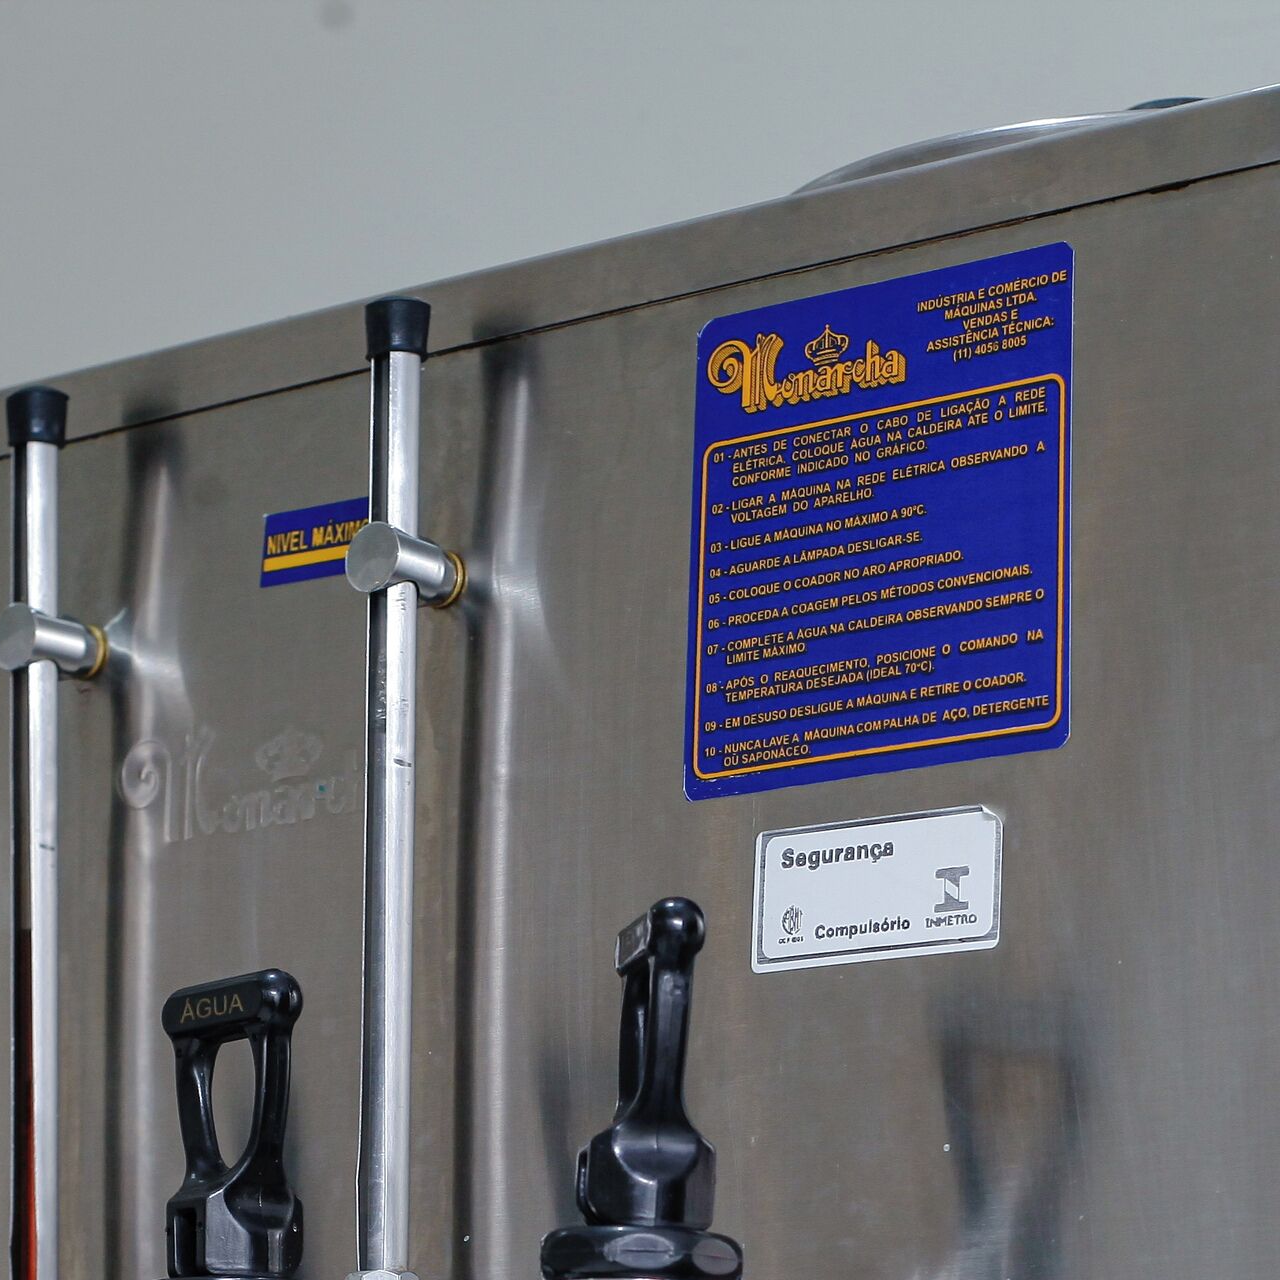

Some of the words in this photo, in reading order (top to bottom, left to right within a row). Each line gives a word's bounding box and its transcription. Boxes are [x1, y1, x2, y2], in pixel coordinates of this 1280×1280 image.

[917, 290, 976, 312] INDÚSTRIA
[978, 287, 985, 300] E
[988, 274, 1049, 297] COMÉRCIO
[1051, 269, 1067, 283] DE
[944, 298, 1003, 320] MÁQUINAS
[1006, 291, 1037, 307] LTDA.
[926, 327, 999, 352] ASSISTÊNCIA
[1001, 315, 1054, 336] TÉCNICA:
[962, 311, 1008, 330] VENDAS
[1010, 308, 1018, 320] E
[953, 347, 972, 362] (11)
[974, 341, 999, 355] 4056
[1001, 335, 1027, 350] 8005
[707, 333, 906, 413] Monarcha
[713, 452, 724, 463] 01
[733, 443, 768, 460] ANTES
[773, 439, 787, 452] DE
[793, 426, 851, 447] CONECTAR
[859, 423, 869, 434] O
[877, 415, 909, 430] CABO
[917, 409, 932, 423] DE
[940, 398, 990, 418] LIGAÇÃO
[998, 395, 1007, 406] A
[1015, 386, 1046, 402] REDE
[791, 441, 844, 461] COLOQUE
[886, 430, 903, 442] NA
[907, 418, 963, 438] CALDEIRA
[994, 410, 1003, 421] O
[1008, 401, 1048, 418] LIMITE,
[711, 503, 723, 515] 02
[732, 495, 763, 511] LIGAR
[768, 493, 776, 504] A
[836, 478, 851, 490] NA
[857, 471, 886, 486] REDE
[892, 460, 946, 480] ELÉTRICA
[950, 444, 1028, 468] OBSERVANDO
[1036, 440, 1045, 452] A
[732, 466, 791, 487] CONFORME
[797, 455, 849, 474] INDICADO
[854, 450, 871, 463] NO
[876, 439, 928, 459] GRÁFICO.
[730, 503, 787, 524] VOLTAGEM
[792, 499, 809, 512] DO
[813, 487, 873, 508] APARELHO.
[267, 530, 308, 555] NIVEL
[312, 519, 369, 547] MÁXIM
[710, 542, 722, 554] 03
[730, 534, 761, 550] LIGUE
[763, 533, 772, 544] A
[826, 519, 842, 531] NO
[890, 509, 899, 520] A
[709, 568, 721, 579] 04
[729, 556, 781, 575] AGUARDE
[782, 555, 791, 566] A
[793, 545, 845, 564] LÂMPADA
[847, 530, 923, 554] DESLIGAR-SE.
[708, 593, 721, 604] 05
[728, 582, 780, 601] COLOQUE
[783, 580, 792, 591] O
[794, 571, 841, 589] COADOR
[844, 568, 860, 580] NO
[861, 563, 886, 577] ARO
[888, 550, 964, 572] APROPRIADO.
[708, 618, 720, 630] 06
[728, 608, 779, 626] PROCEDA
[781, 606, 789, 617] A
[791, 597, 839, 615] COAGEM
[841, 590, 878, 606] PELOS
[880, 580, 935, 599] MÉTODOS
[937, 563, 1033, 590] CONVENCIONAIS.
[707, 644, 719, 655] 07
[727, 632, 784, 652] COMPLETE
[786, 631, 794, 642] A
[830, 622, 845, 634] NA
[848, 612, 904, 631] CALDEIRA
[906, 598, 983, 621] OBSERVANDO
[985, 590, 1032, 608] SEMPRE
[1035, 588, 1045, 600] O
[706, 682, 718, 694] 08
[725, 676, 755, 690] APÓS
[760, 674, 769, 684] O
[876, 645, 936, 665] POSICIONE
[941, 643, 951, 655] O
[959, 632, 1018, 652] COMANDO
[1027, 628, 1044, 641] NA
[726, 649, 760, 665] LIMITE
[704, 720, 717, 732] 09
[725, 716, 741, 729] EM
[743, 709, 787, 726] DESUSO
[789, 699, 843, 718] DESLIGUE
[845, 698, 854, 709] A
[910, 688, 917, 700] E
[920, 681, 960, 698] RETIRE
[962, 680, 972, 691] O
[974, 671, 1026, 689] COADOR.
[725, 681, 804, 703] TEMPERATURA
[806, 671, 864, 690] DESEJADA
[866, 665, 902, 682] (IDEAL
[704, 746, 716, 757] 10
[724, 739, 762, 755] NUNCA
[762, 734, 790, 748] LAVE
[791, 733, 800, 744] A
[856, 720, 882, 733] COM
[883, 714, 920, 729] PALHA
[922, 711, 937, 724] DE
[972, 694, 1049, 716] DETERGENTE
[741, 743, 811, 764] SAPONÁCEO.
[781, 841, 894, 870] Segurança
[815, 916, 910, 940] Compulsório
[925, 913, 977, 929] INMETRO
